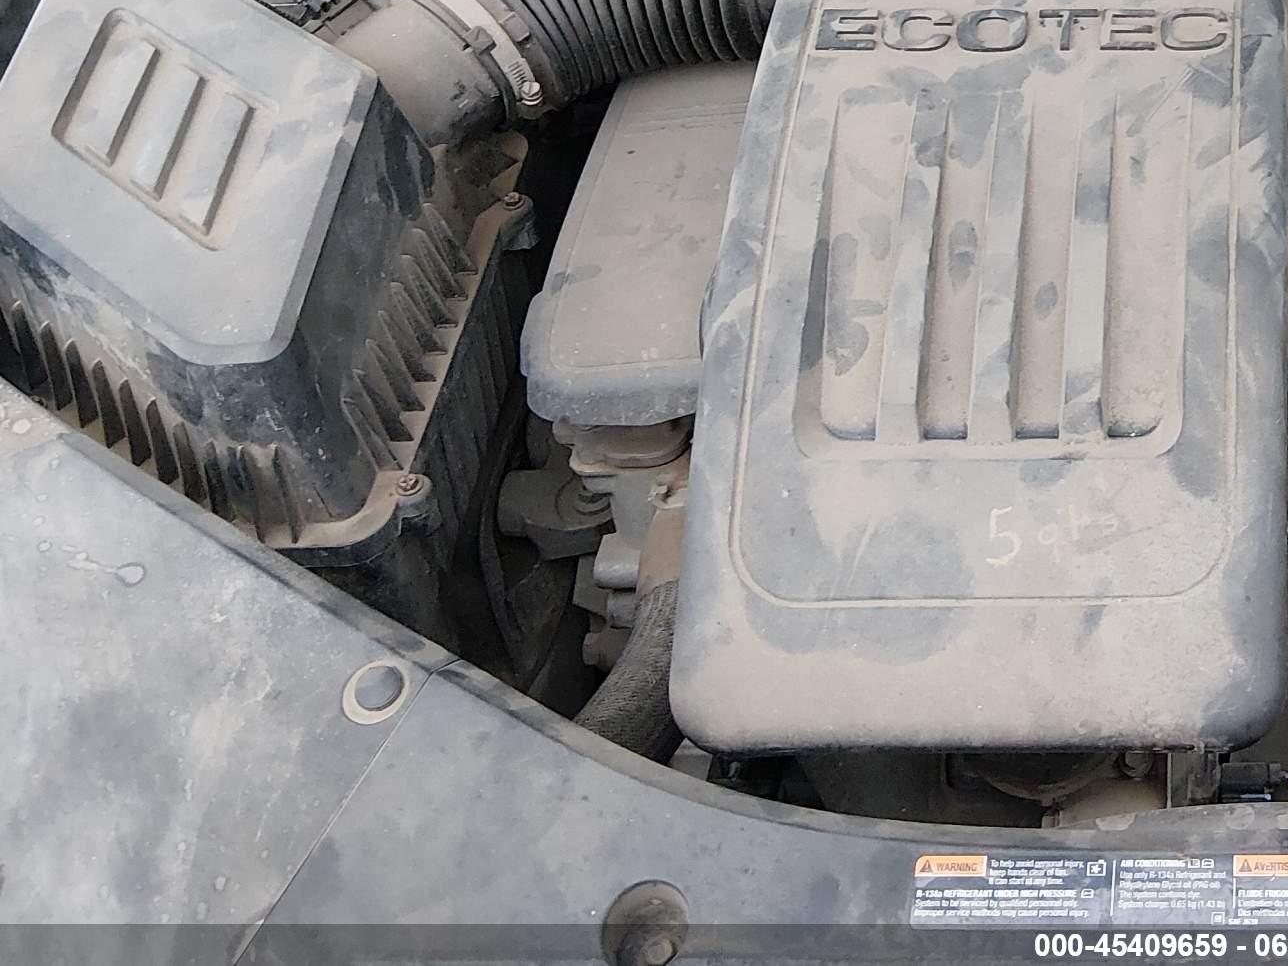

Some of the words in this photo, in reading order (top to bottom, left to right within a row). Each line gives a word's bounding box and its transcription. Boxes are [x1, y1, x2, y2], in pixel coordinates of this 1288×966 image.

[815, 7, 1230, 52] ECOTEC
[985, 505, 1022, 566] 5
[937, 862, 977, 872] WARNING
